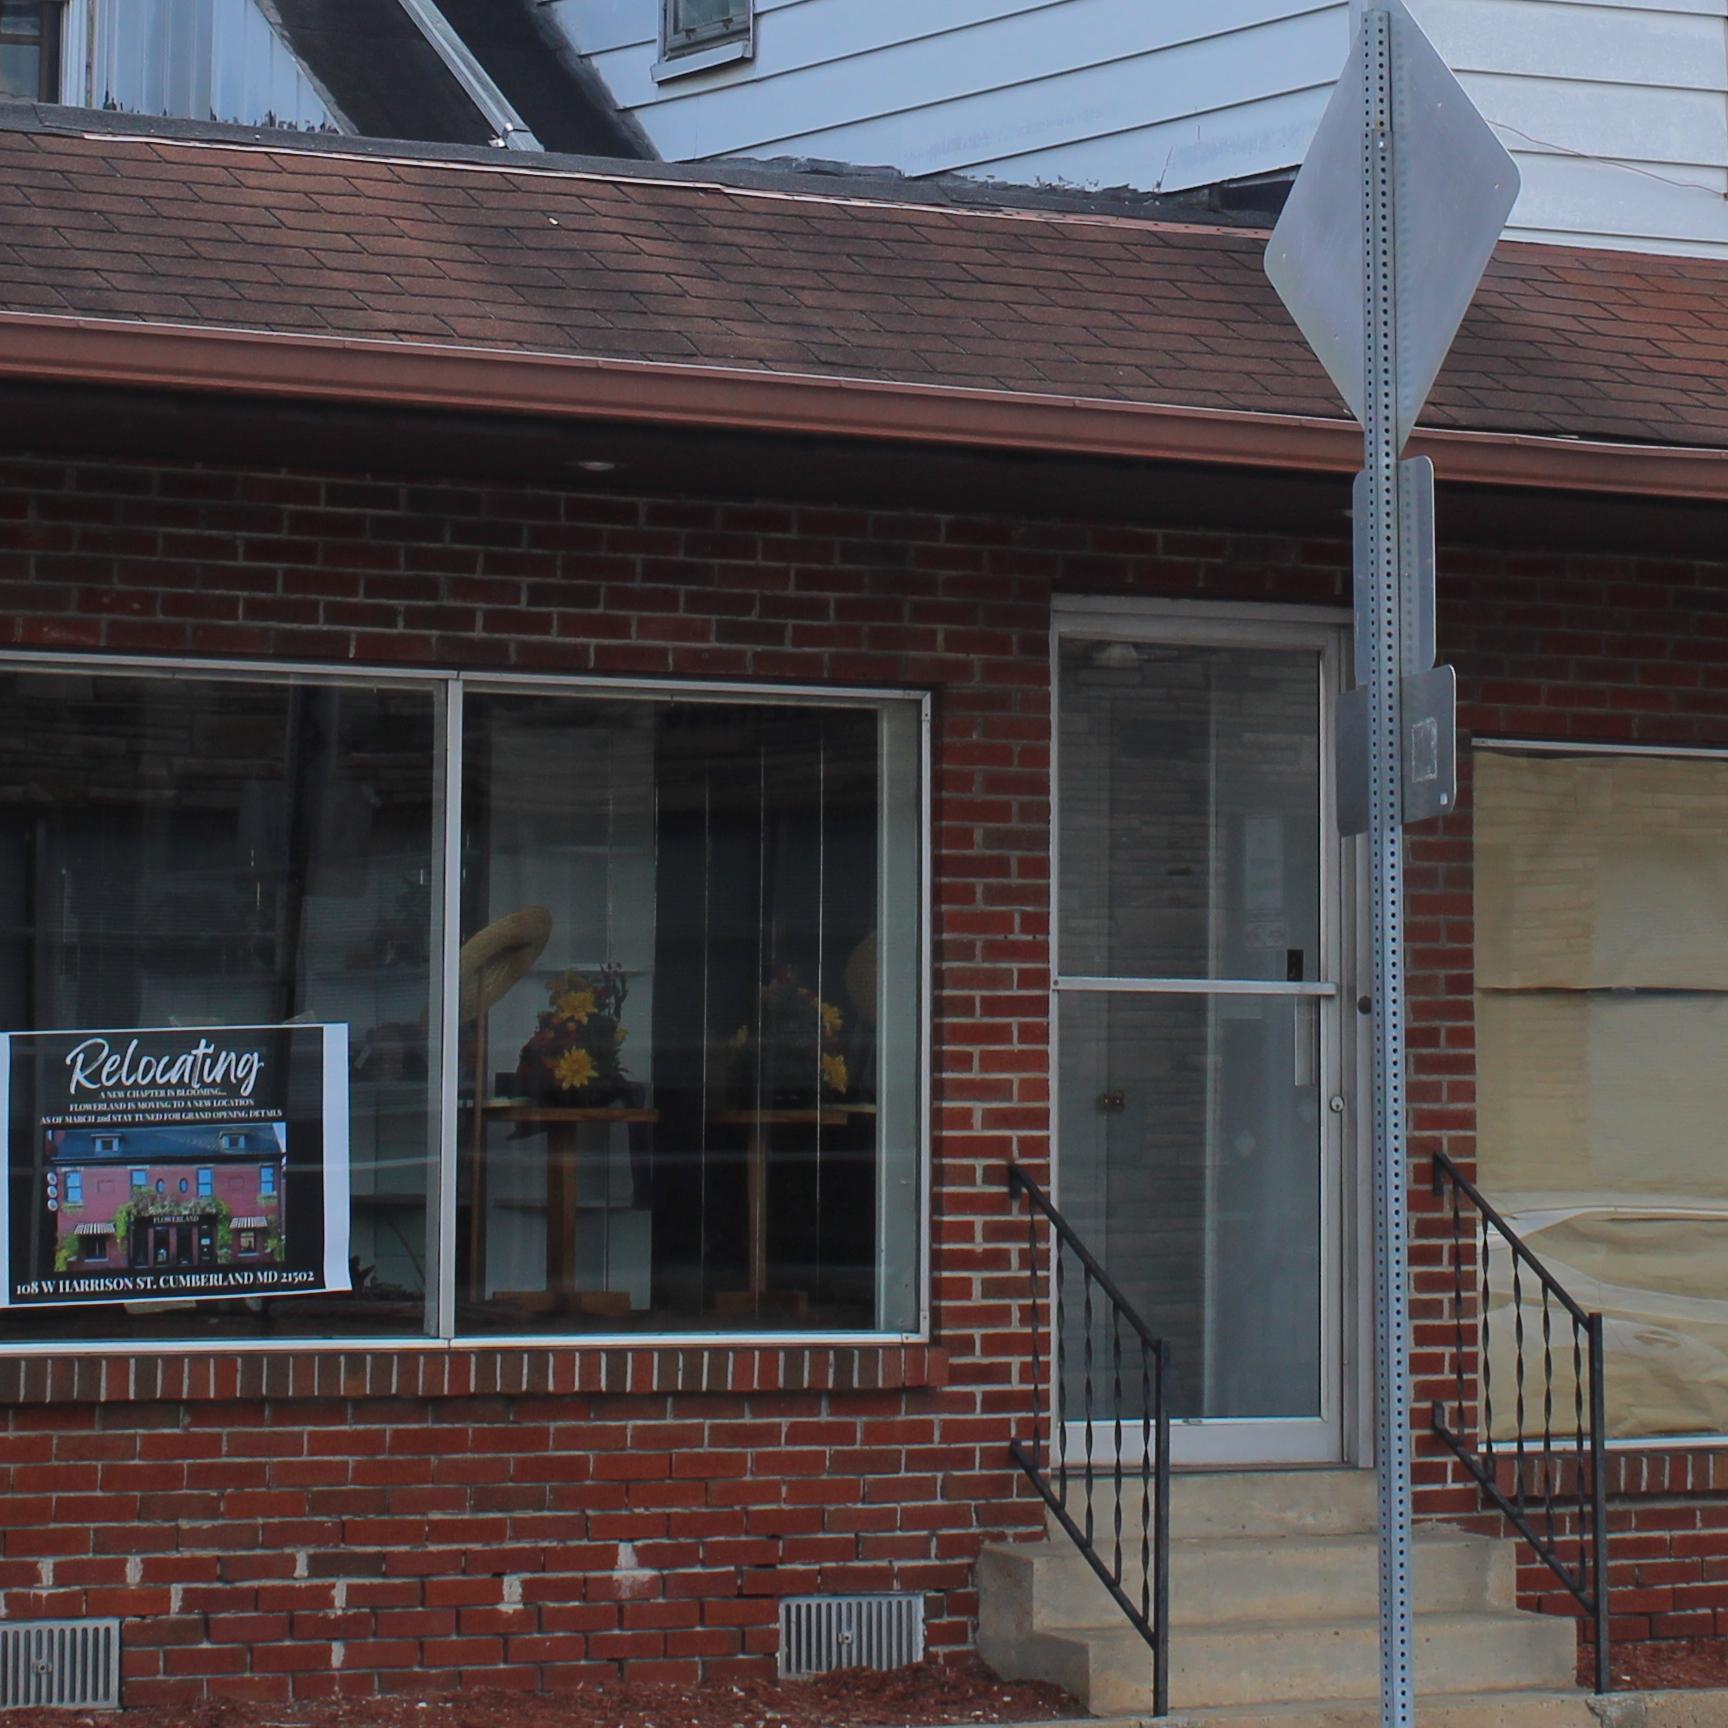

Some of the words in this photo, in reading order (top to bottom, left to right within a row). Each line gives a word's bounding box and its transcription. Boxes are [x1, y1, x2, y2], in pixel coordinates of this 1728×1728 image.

[65, 1037, 265, 1097] Relocating
[107, 1090, 126, 1099] NEW
[126, 1089, 166, 1099] CHAPTER
[167, 1089, 176, 1097] IS
[69, 1101, 127, 1112] FLOWERLAND
[127, 1101, 136, 1111] IS
[137, 1100, 171, 1111] MOVING
[173, 1100, 184, 1108] TO
[193, 1099, 212, 1108] NEW
[213, 1098, 255, 1107] LOCATION
[40, 1116, 51, 1125] AS
[52, 1116, 63, 1124] OF
[64, 1114, 95, 1124] MARCH
[112, 1113, 133, 1122] STAY
[134, 1112, 163, 1122] TUNED
[164, 1111, 181, 1121] FOR
[182, 1111, 212, 1120] GRAND
[213, 1110, 248, 1119] OPENING
[249, 1108, 283, 1118] DETAILS
[16, 1280, 39, 1295] 108
[41, 1280, 56, 1293] W
[58, 1276, 134, 1293] HARRISON
[136, 1276, 157, 1290] ST.
[159, 1272, 254, 1288] CUMBERLAND
[256, 1271, 279, 1284] MD
[281, 1270, 315, 1285] 21502
